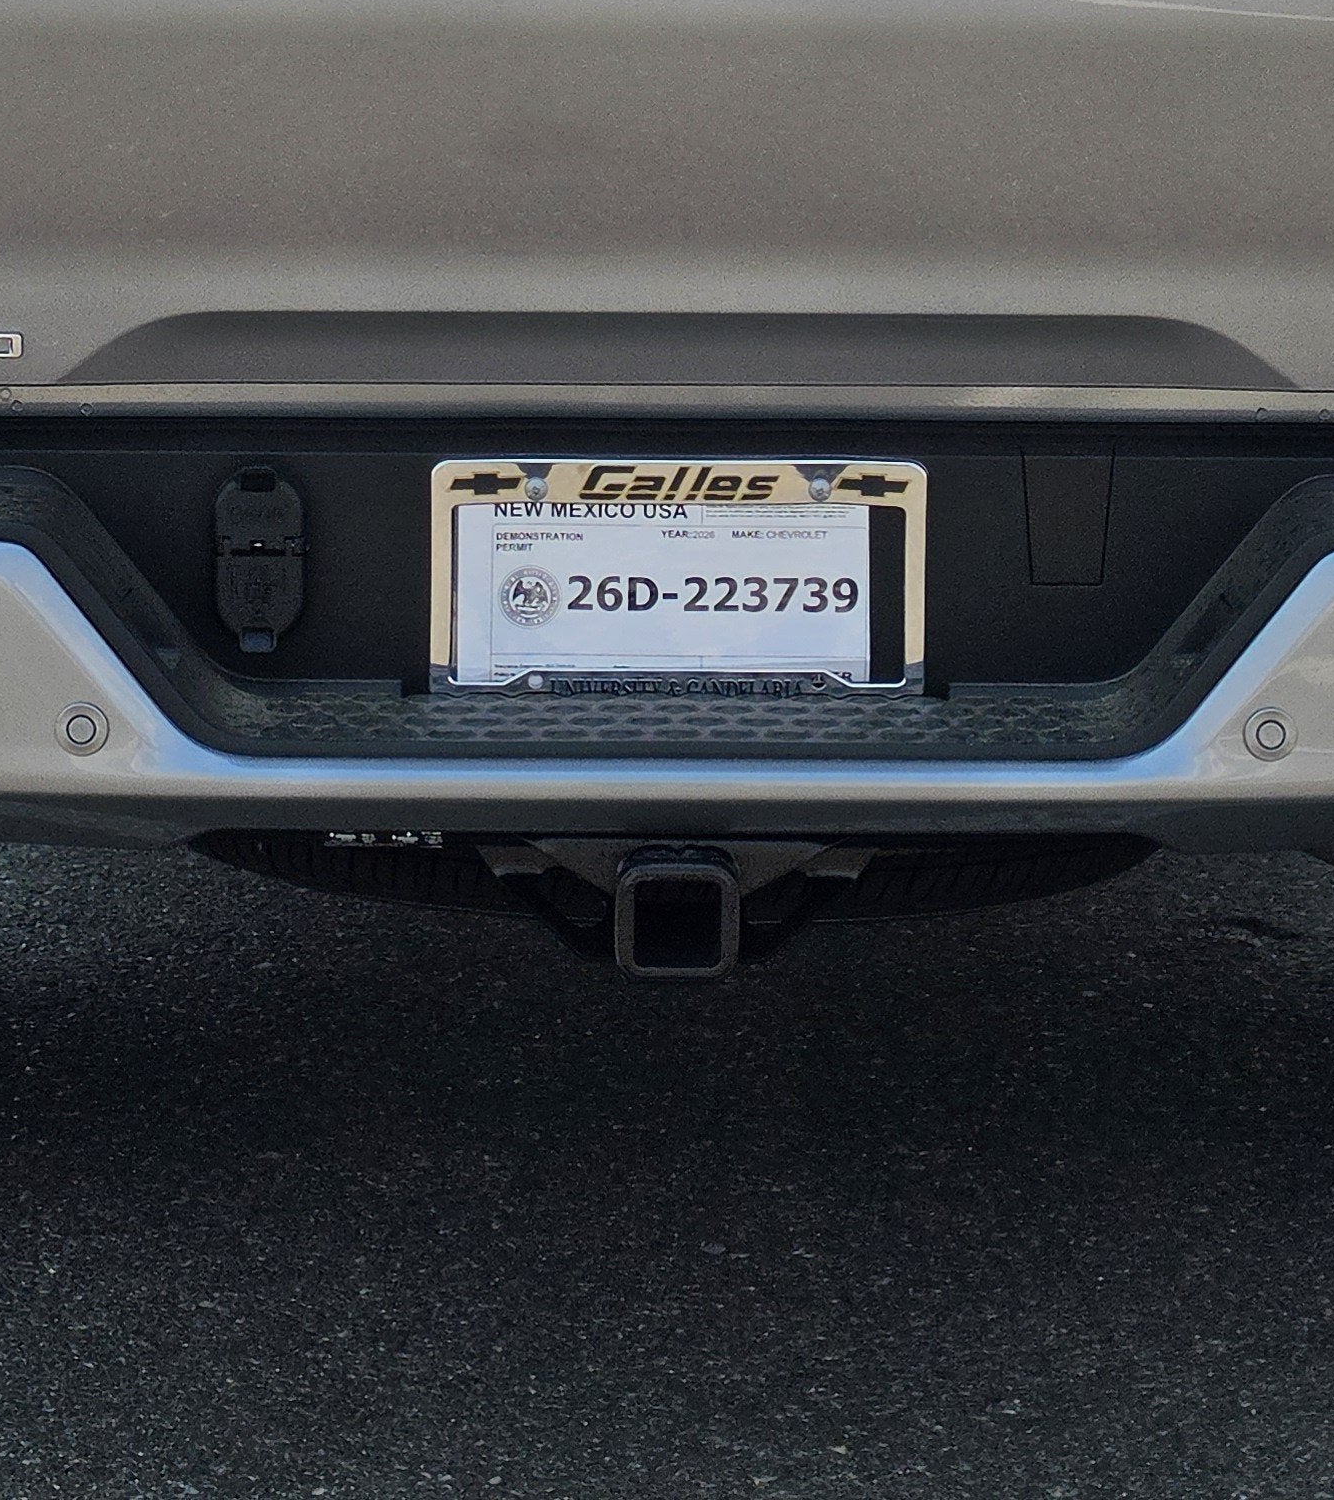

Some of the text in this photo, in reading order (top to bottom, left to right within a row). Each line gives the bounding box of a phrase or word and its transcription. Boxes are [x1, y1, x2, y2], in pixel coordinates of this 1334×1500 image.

[577, 465, 780, 500] Galles
[494, 503, 542, 518] NEW
[550, 503, 636, 519] MEXICO
[643, 503, 688, 519] USA
[495, 532, 584, 541] DEMONSTRATION
[766, 530, 828, 540] CHEVROLET
[495, 543, 533, 552] PERMIT
[567, 575, 860, 613] 26D-223739
